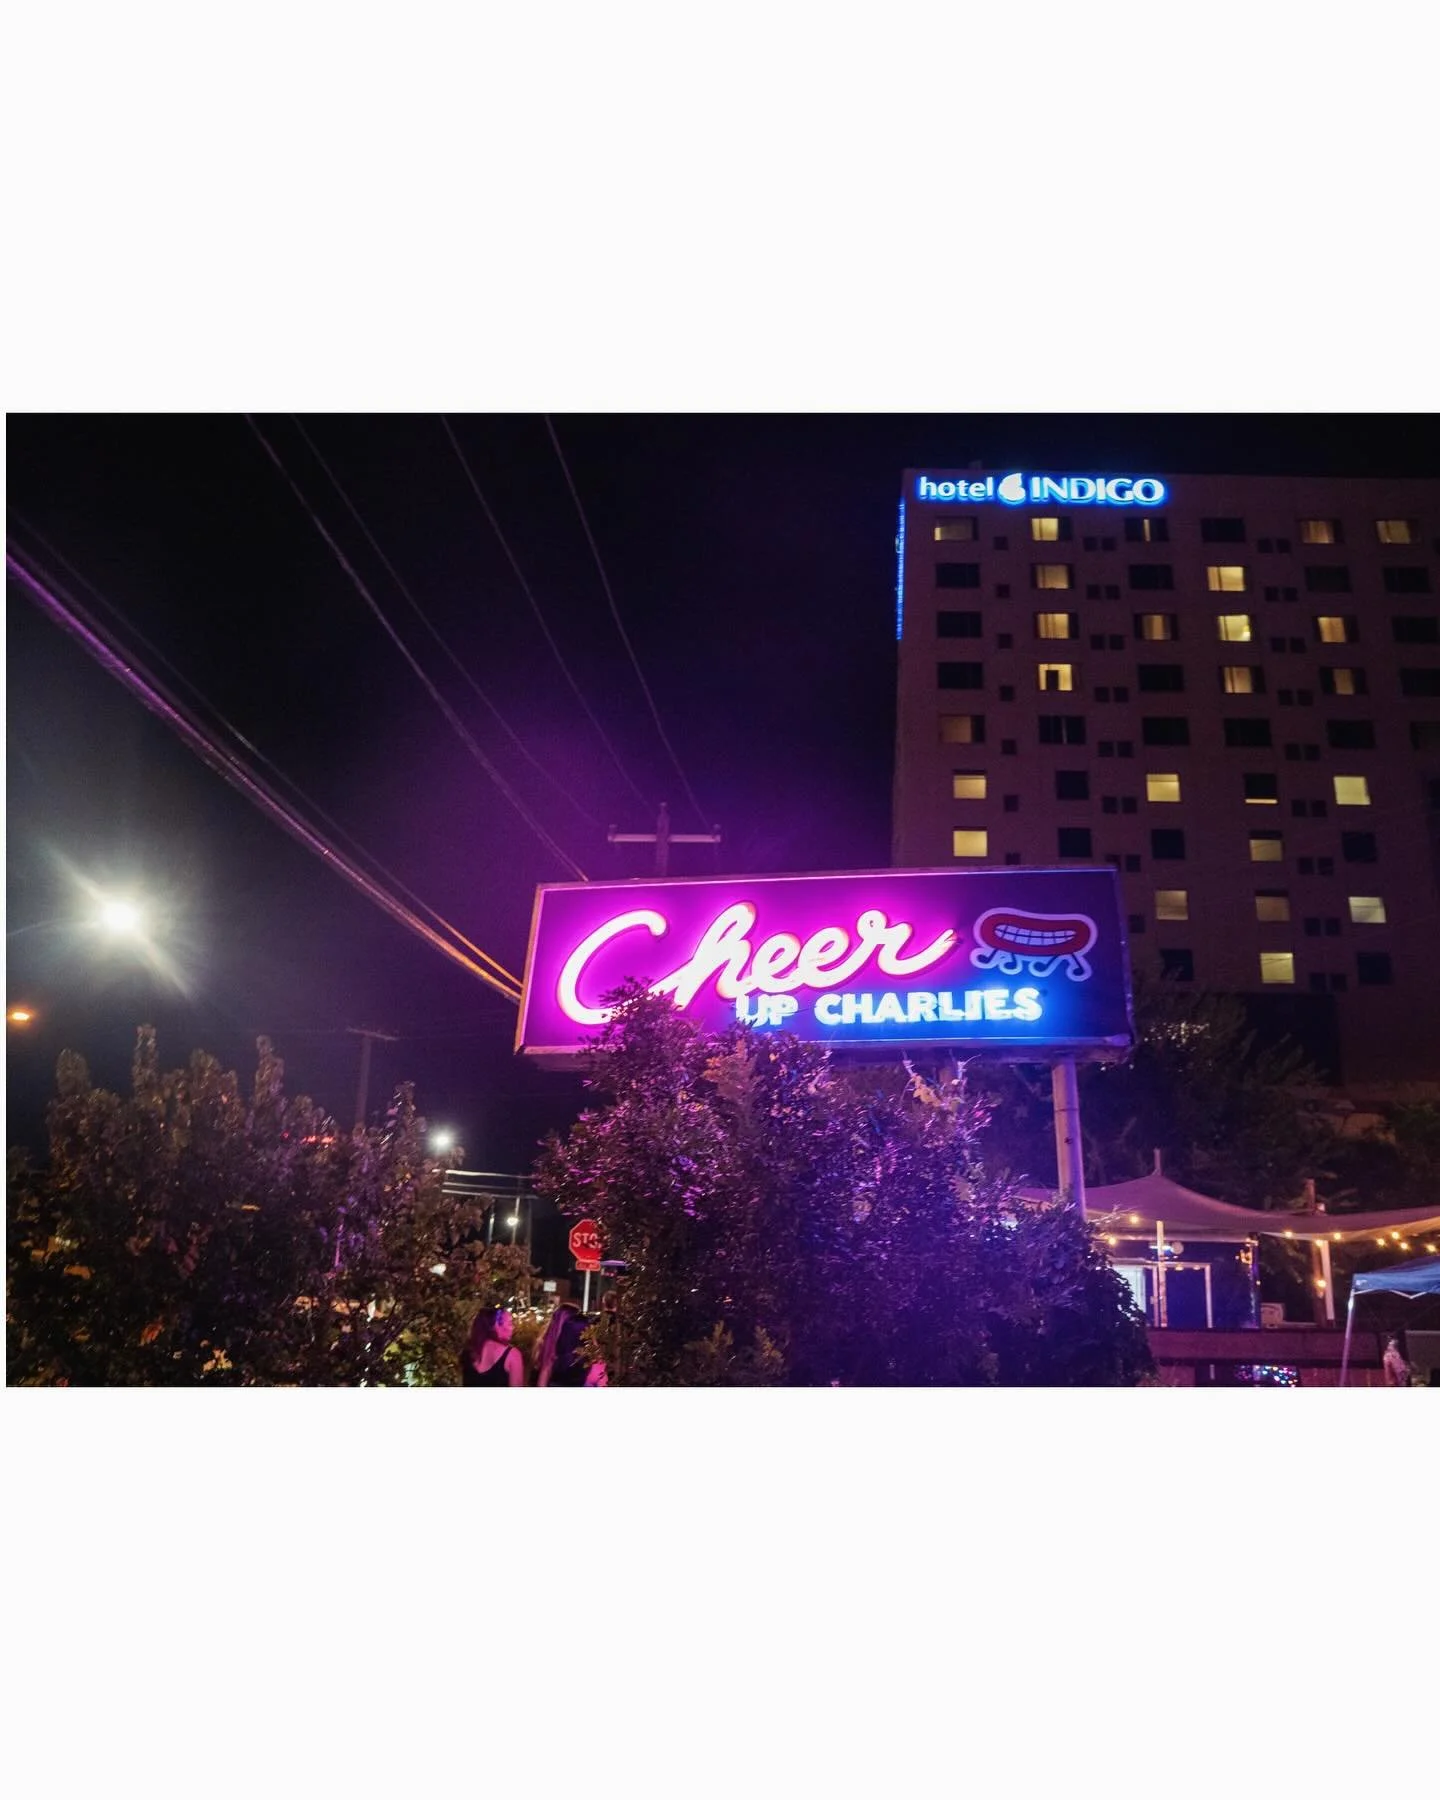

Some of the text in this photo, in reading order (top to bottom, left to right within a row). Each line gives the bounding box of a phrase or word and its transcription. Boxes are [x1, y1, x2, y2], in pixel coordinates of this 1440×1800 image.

[919, 476, 1165, 503] hotel INDIGO
[556, 901, 960, 1025] Cheer
[735, 987, 1043, 1026] UP CHARLIES
[572, 1232, 602, 1249] STO
